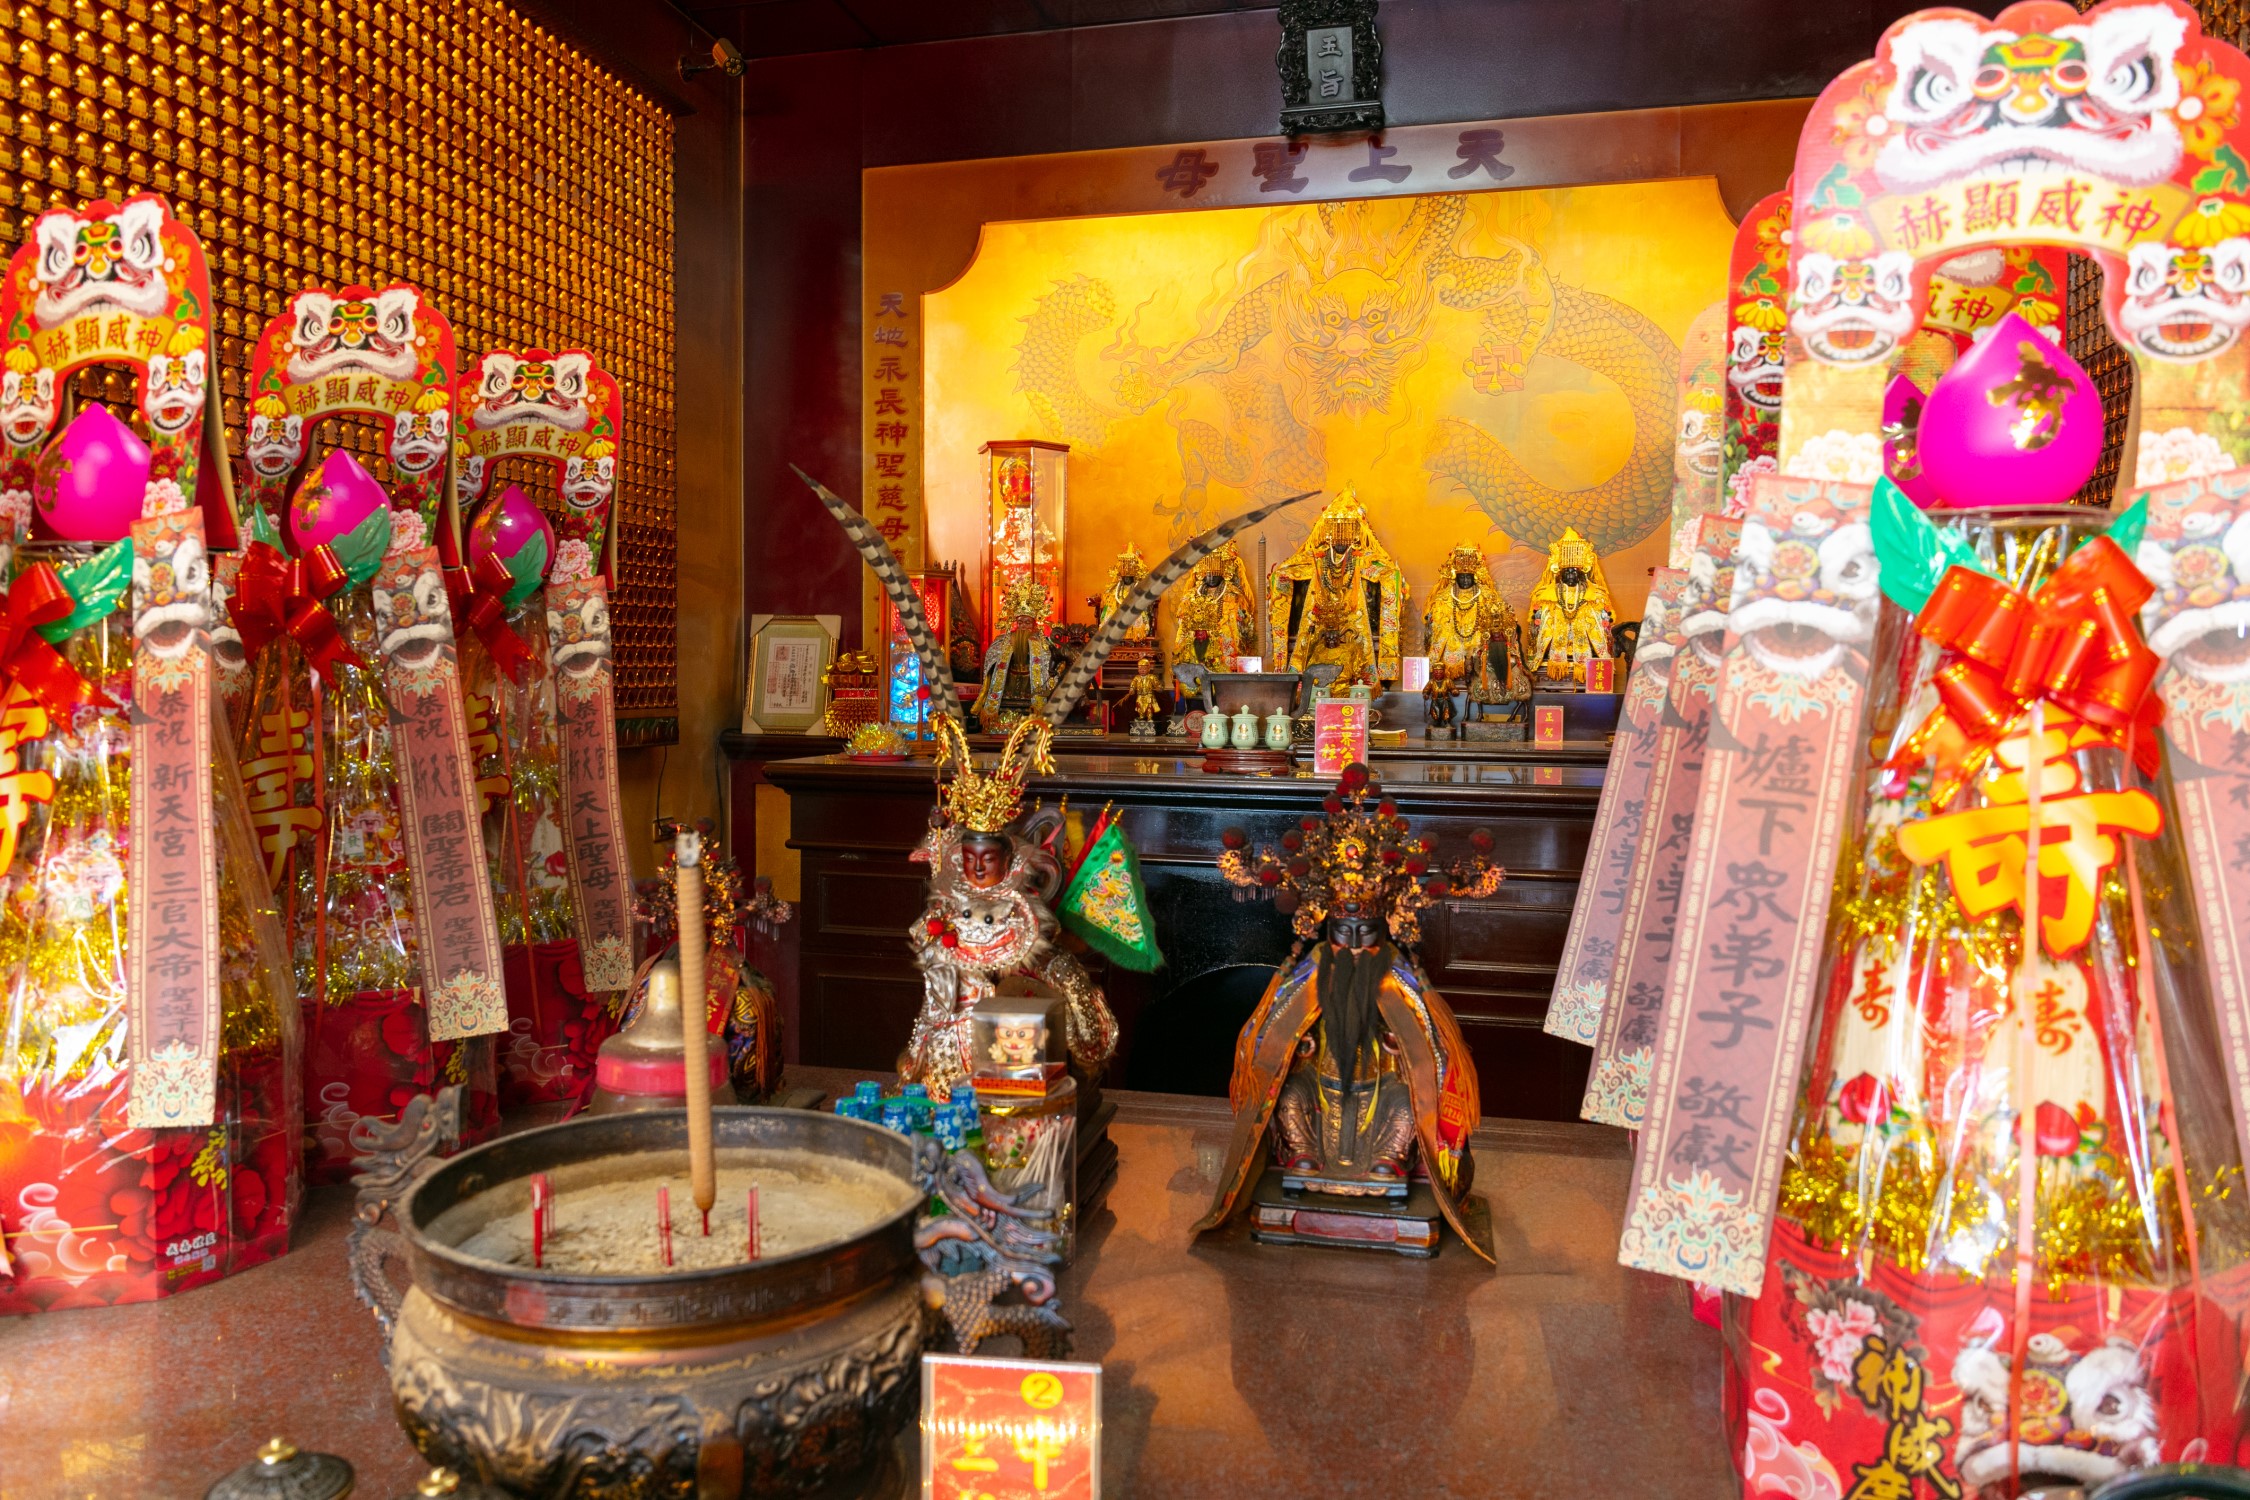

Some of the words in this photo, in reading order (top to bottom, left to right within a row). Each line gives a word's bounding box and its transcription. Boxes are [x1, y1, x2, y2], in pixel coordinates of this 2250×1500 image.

[873, 292, 909, 566] 天地永長神聖慈母
[153, 691, 191, 747] 恭祝
[412, 695, 449, 741] 恭祝
[573, 700, 600, 740] 恭祝
[151, 763, 195, 858] 新天宮
[572, 790, 618, 891] 天上聖母
[148, 871, 202, 983] 三官大帝
